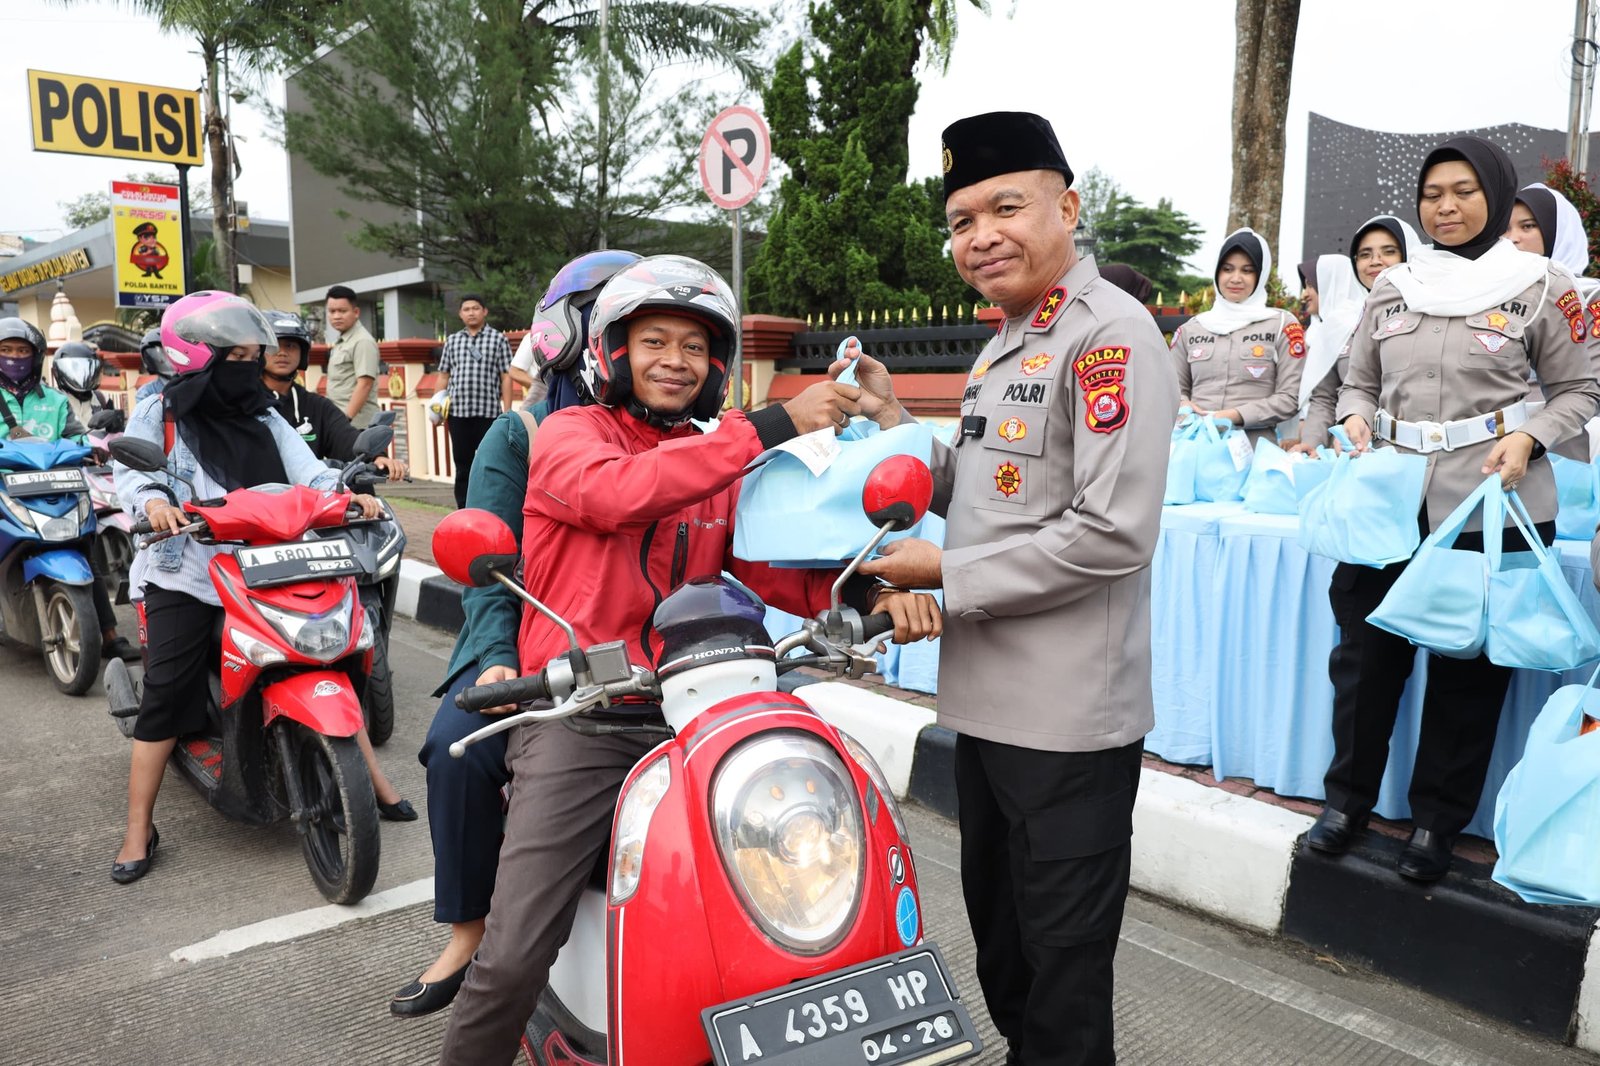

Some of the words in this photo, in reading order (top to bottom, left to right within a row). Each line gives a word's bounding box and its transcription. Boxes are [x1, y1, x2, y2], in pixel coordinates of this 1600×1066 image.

[37, 77, 198, 158] POLISI
[130, 208, 166, 221] PRESISI
[143, 294, 170, 303] YSP
[1189, 335, 1216, 345] OCHA
[1242, 332, 1276, 343] POLRI
[1077, 348, 1124, 372] POLDA
[1084, 370, 1120, 385] BANTEN
[1002, 383, 1046, 404] POLRI
[250, 553, 260, 566] A
[274, 547, 314, 562] 6801
[693, 646, 745, 660] HONDA
[739, 1023, 763, 1061] A
[785, 988, 870, 1044] 4359
[886, 970, 928, 1010] HP
